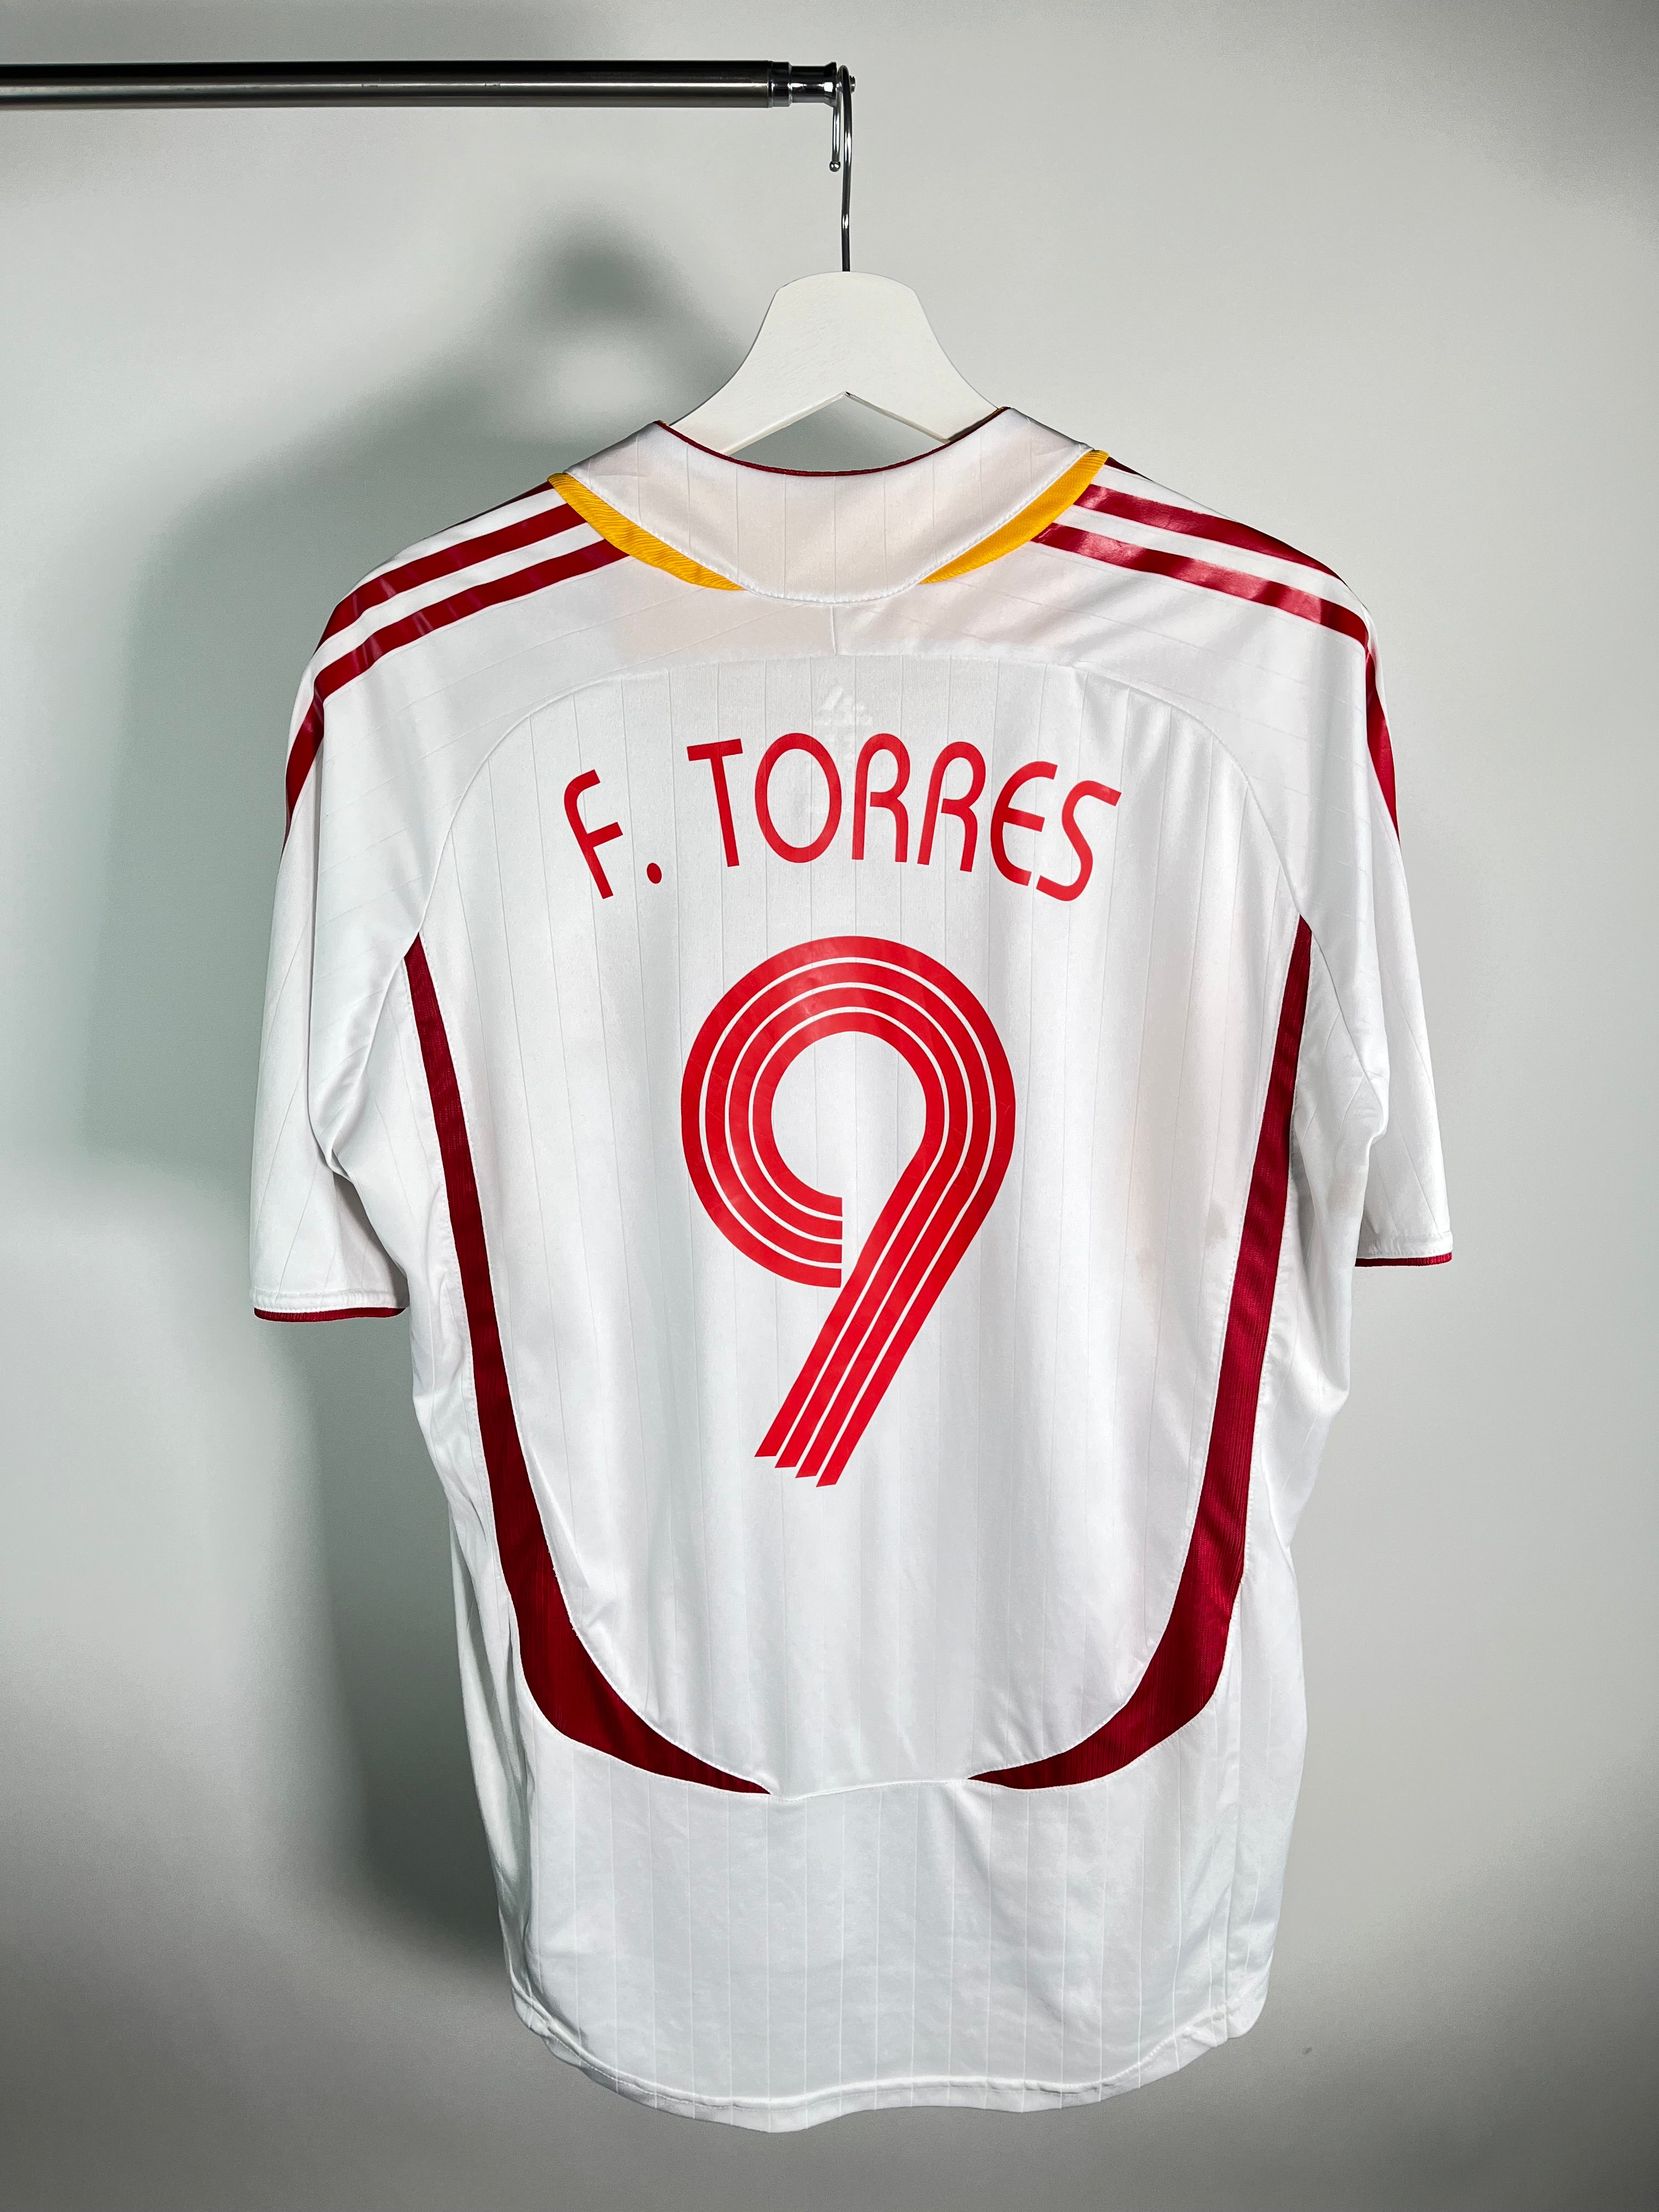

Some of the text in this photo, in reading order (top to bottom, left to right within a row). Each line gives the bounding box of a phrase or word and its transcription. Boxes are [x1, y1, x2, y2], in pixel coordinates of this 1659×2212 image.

[563, 732, 1122, 902] F. TORRES
[680, 935, 1017, 1487] 9
